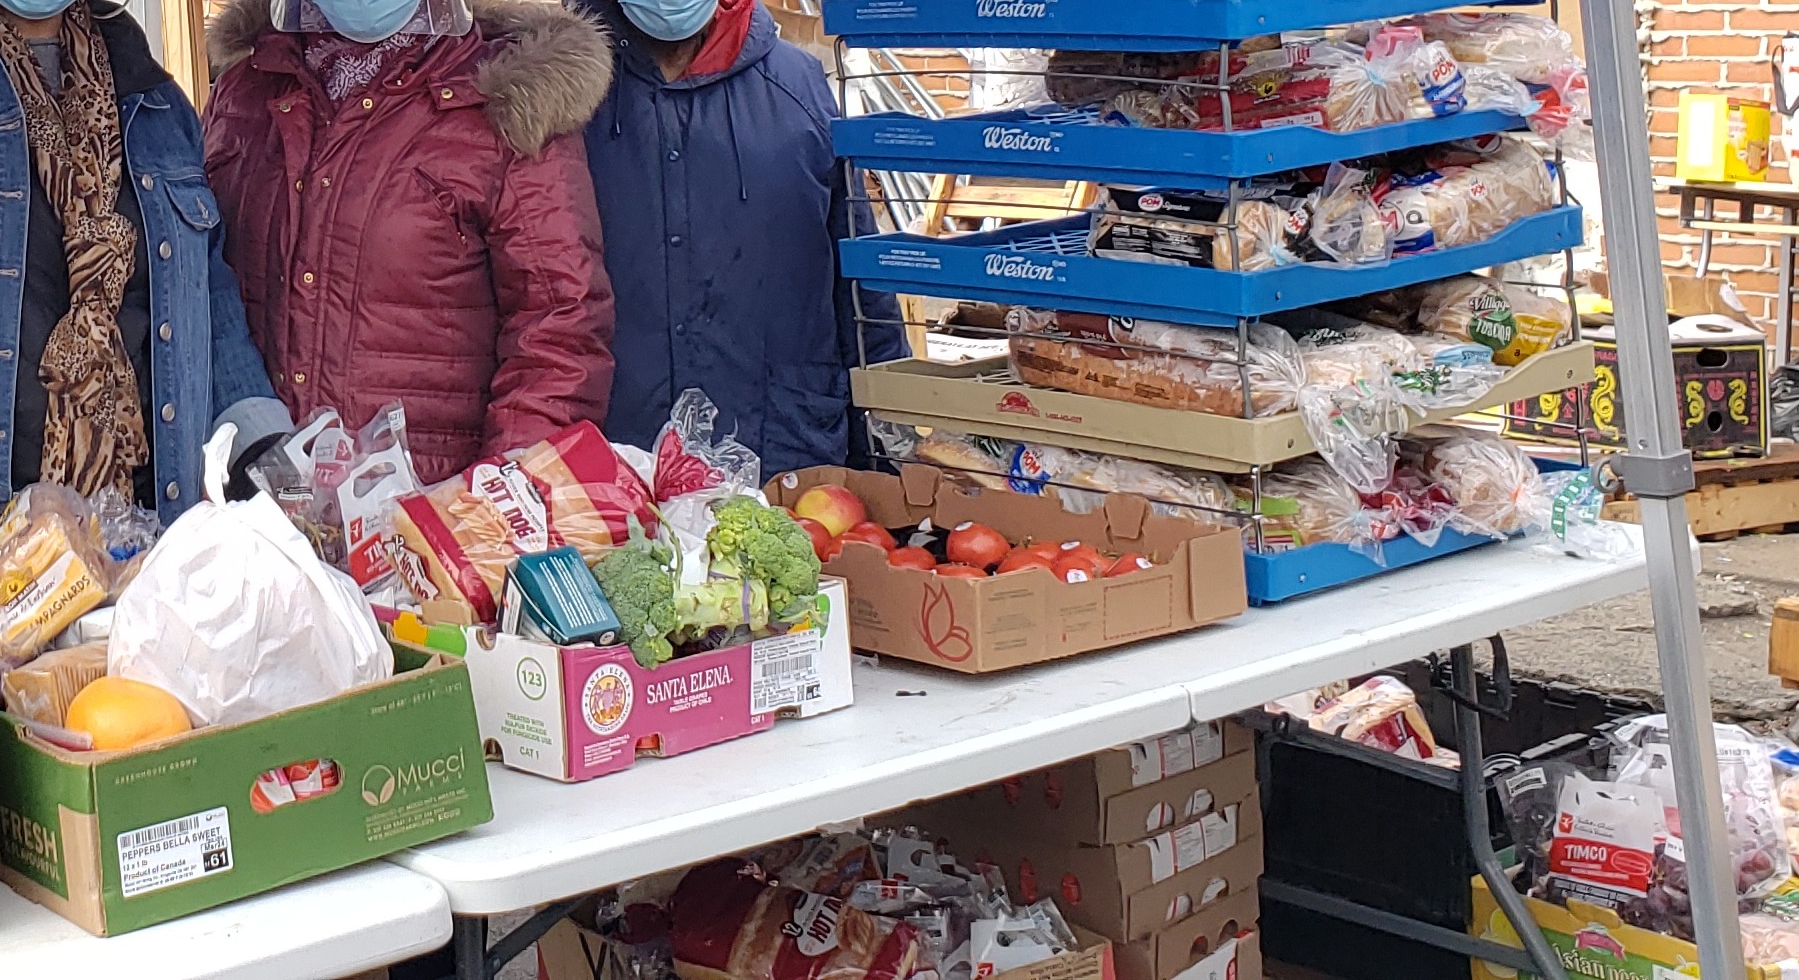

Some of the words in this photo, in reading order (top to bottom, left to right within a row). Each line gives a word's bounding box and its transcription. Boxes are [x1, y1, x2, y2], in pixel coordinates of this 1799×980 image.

[982, 126, 1052, 153] Weston
[984, 253, 1055, 282] Weston
[502, 506, 537, 540] DOG
[521, 669, 543, 687] 123
[646, 681, 688, 705] SANTA
[689, 664, 732, 692] ELENA
[669, 703, 691, 713] PRODUCT
[751, 715, 761, 725] CAT
[501, 725, 513, 735] FOR
[519, 746, 534, 758] CAT
[397, 746, 466, 790] Mucci
[0, 804, 58, 864] FRESH
[121, 842, 161, 862] PEPPERS
[162, 835, 191, 851] BELLA
[192, 826, 221, 842] SWEET
[1564, 843, 1608, 862] TIMCO
[123, 867, 151, 882] Product
[160, 858, 187, 871] Canada
[806, 910, 836, 945] HOT
